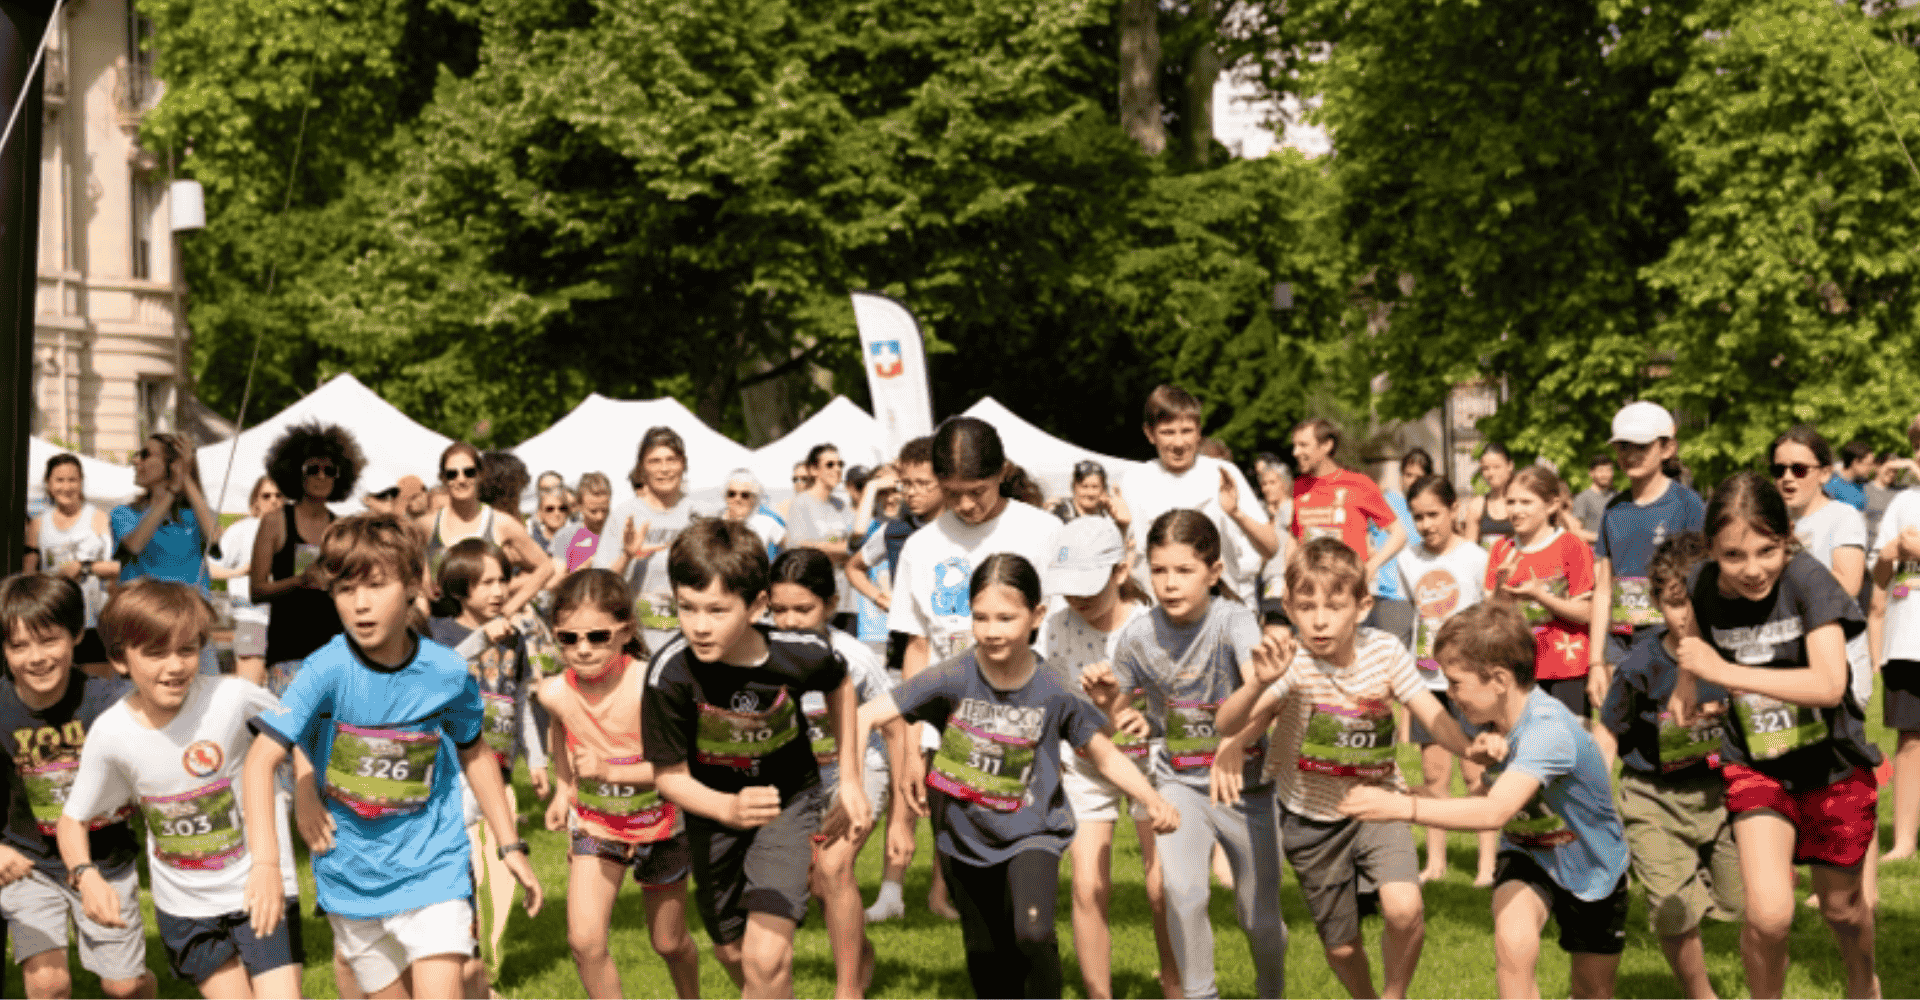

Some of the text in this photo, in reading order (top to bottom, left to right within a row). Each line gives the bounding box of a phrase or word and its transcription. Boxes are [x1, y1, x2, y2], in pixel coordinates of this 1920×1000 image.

[1182, 723, 1213, 738] 30
[1750, 709, 1793, 734] 321
[1334, 731, 1378, 749] 301
[357, 756, 410, 781] 326
[966, 750, 1003, 776] 311
[160, 814, 213, 837] 303
